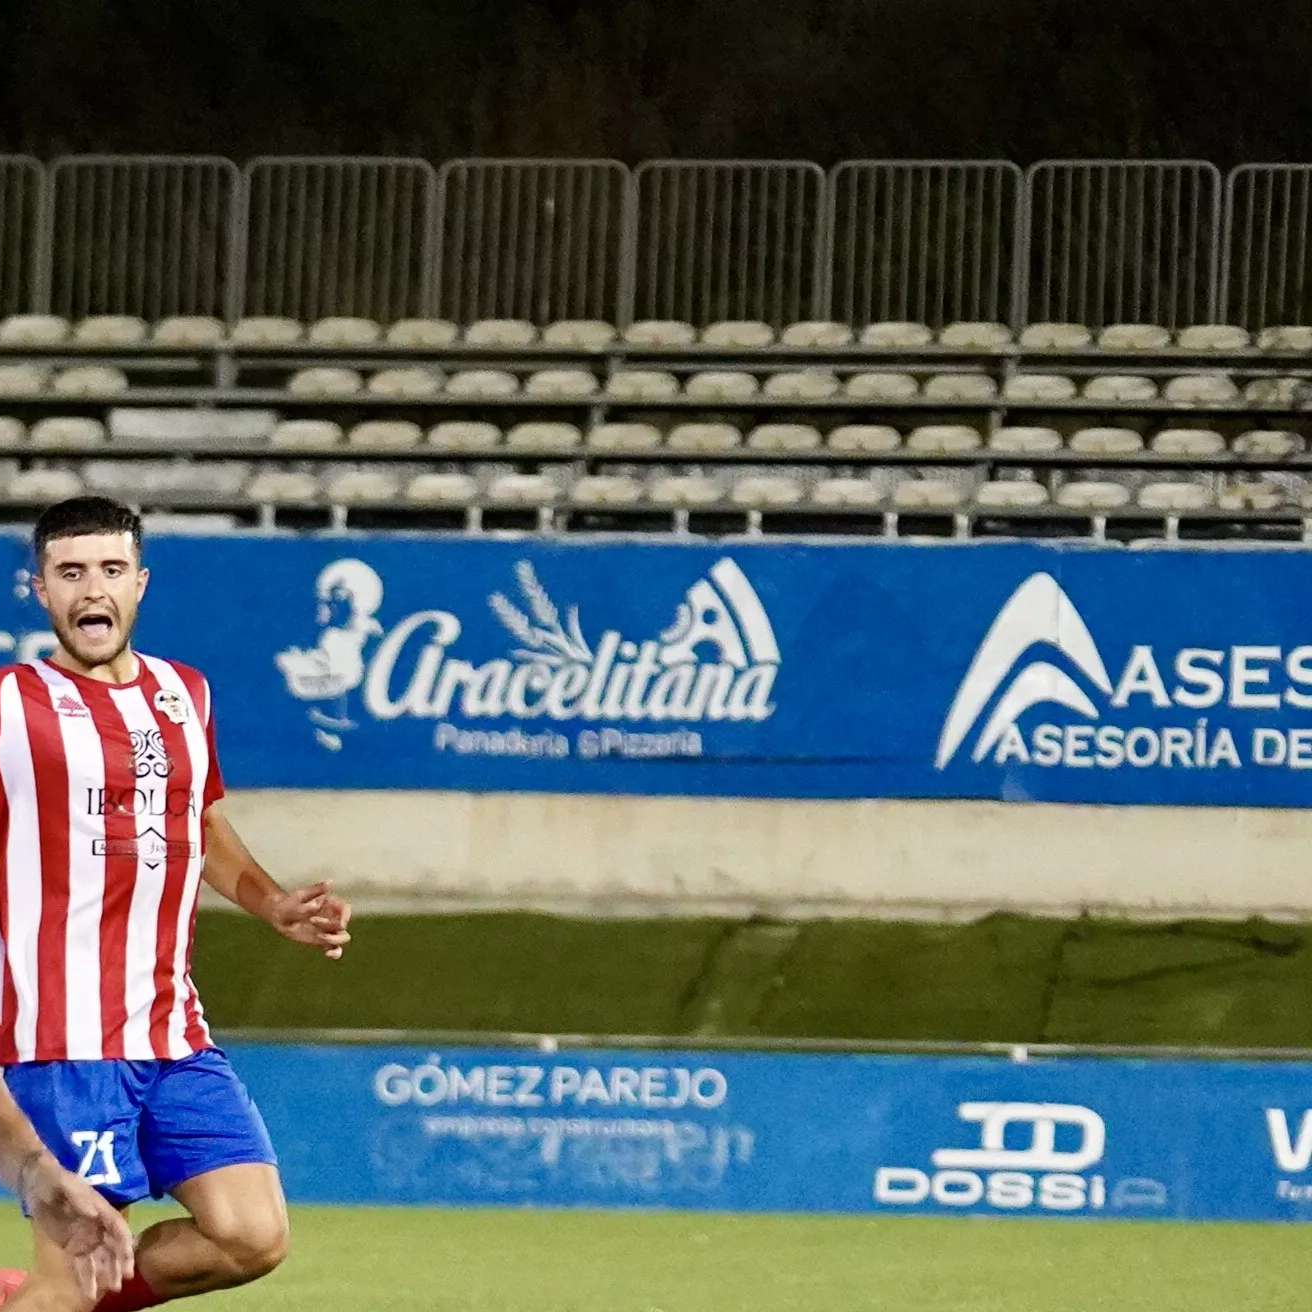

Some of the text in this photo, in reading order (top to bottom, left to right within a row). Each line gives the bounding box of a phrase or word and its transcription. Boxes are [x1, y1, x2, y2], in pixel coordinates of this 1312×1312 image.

[994, 720, 1242, 768] ASESORÍA
[376, 1054, 727, 1109] GÓMEZ PAREJO
[71, 1131, 121, 1186] 21
